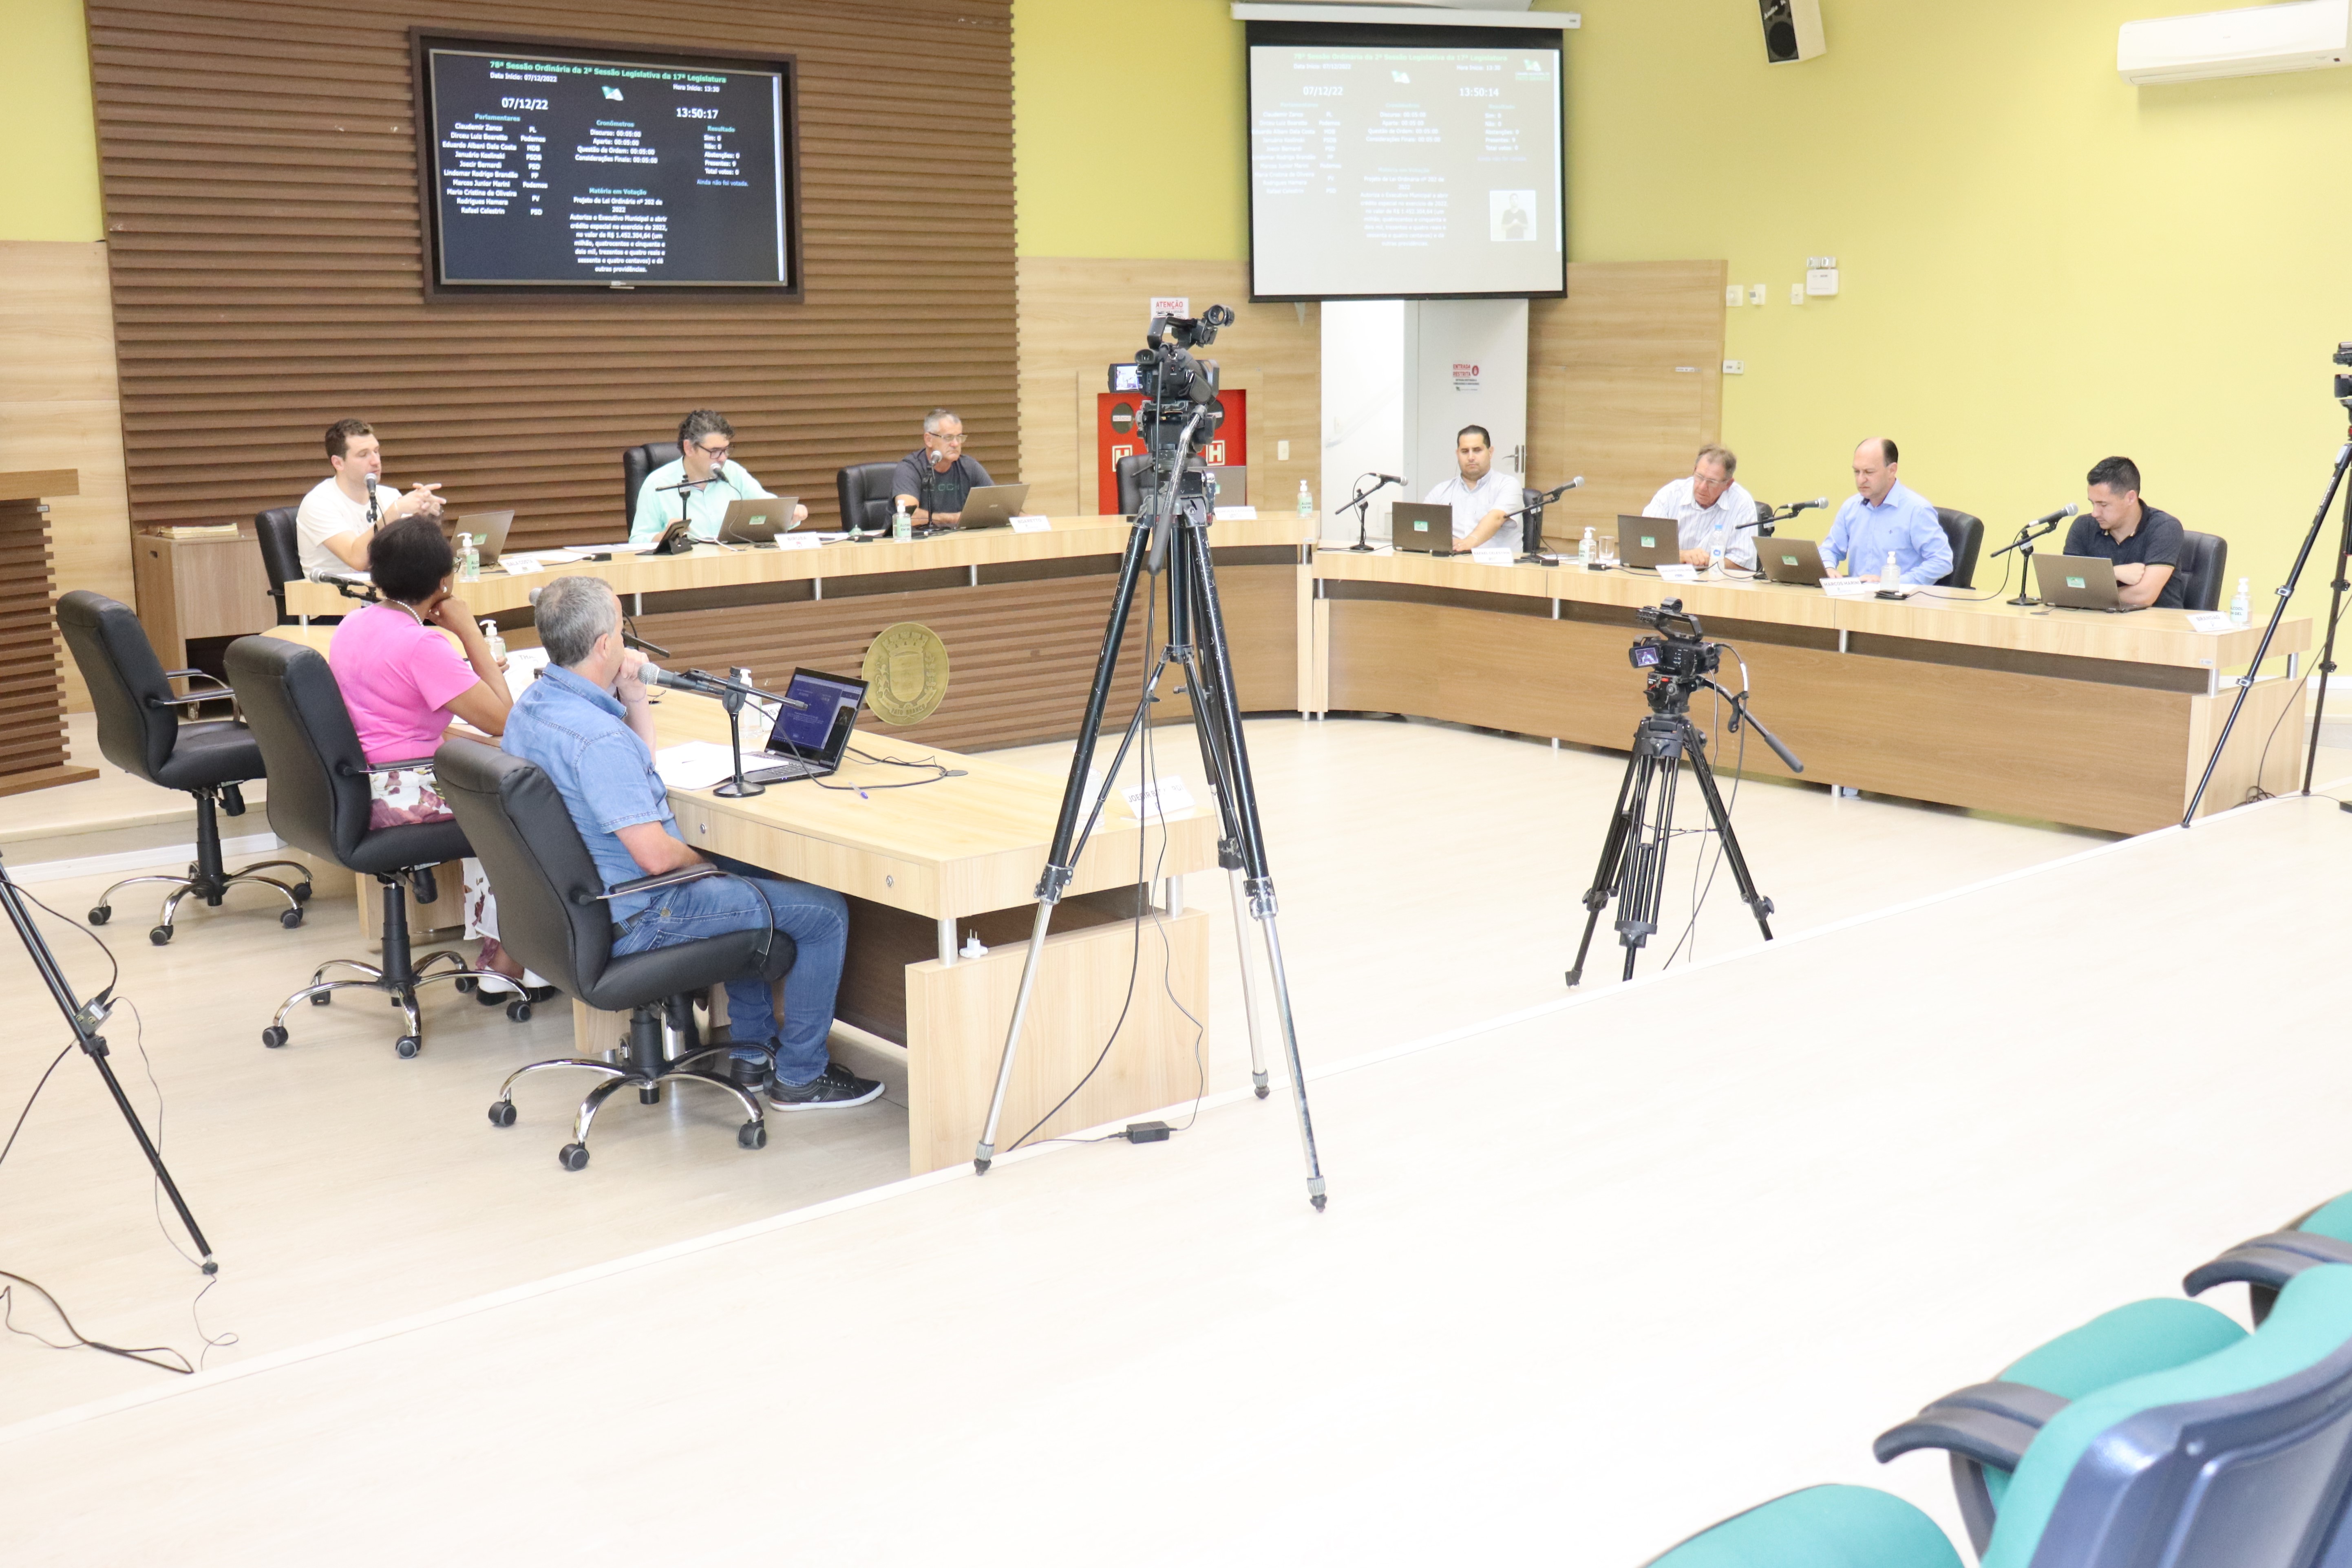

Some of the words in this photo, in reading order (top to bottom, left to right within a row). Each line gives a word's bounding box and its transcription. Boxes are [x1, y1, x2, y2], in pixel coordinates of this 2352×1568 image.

[535, 64, 571, 73] Ordinária
[524, 74, 557, 82] 07/12/2022
[1303, 86, 1343, 97] 07/12/22
[1459, 87, 1499, 97] 13:50:14
[501, 97, 548, 110] 07/12/22
[676, 107, 718, 119] 13:50:17
[575, 154, 614, 162] Considerações
[471, 170, 495, 178] Rodrigo
[457, 197, 485, 205] Rodrigues
[1156, 300, 1184, 309] ATENÇÃO
[1209, 444, 1222, 462] H
[906, 703, 925, 715] BRANCO
